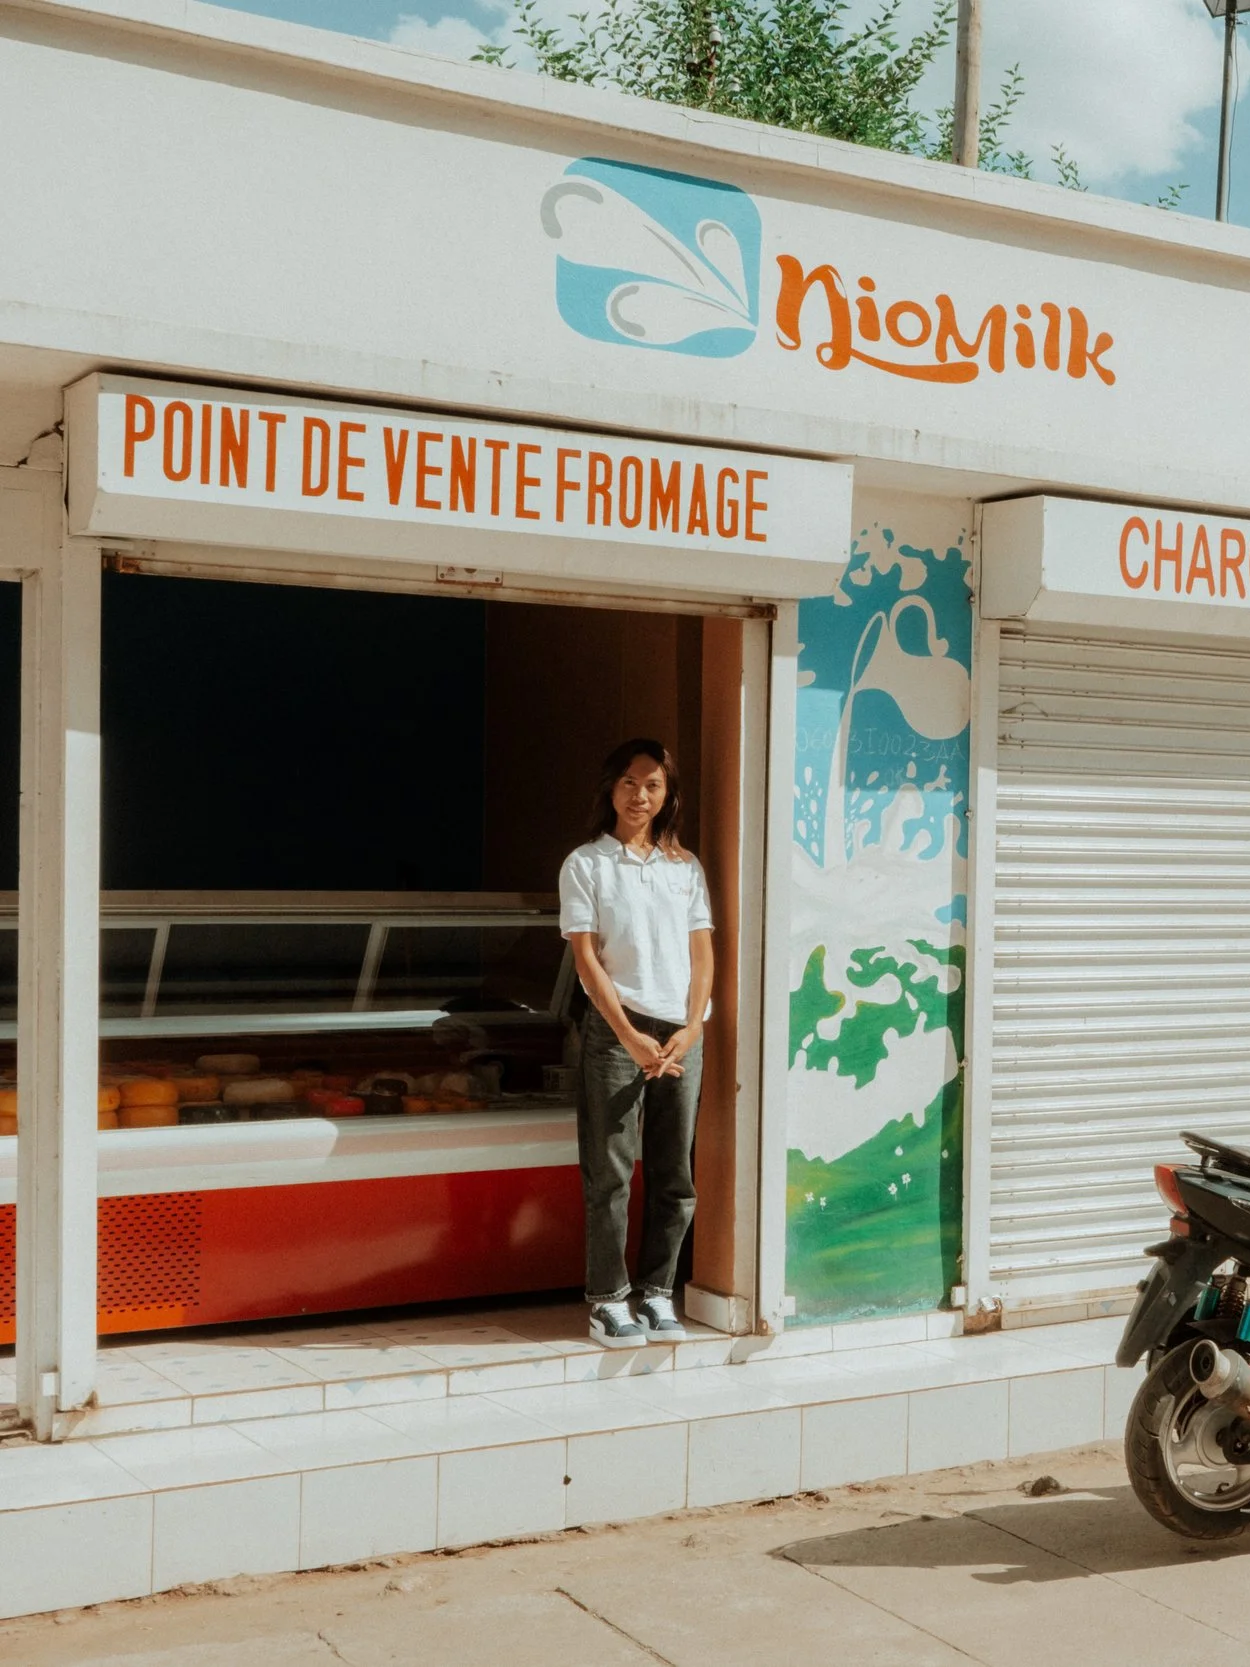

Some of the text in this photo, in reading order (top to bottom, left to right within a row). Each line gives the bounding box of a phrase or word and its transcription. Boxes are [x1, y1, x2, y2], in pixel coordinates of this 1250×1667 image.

[123, 393, 769, 543] POINT DE VENTE FROMAGE
